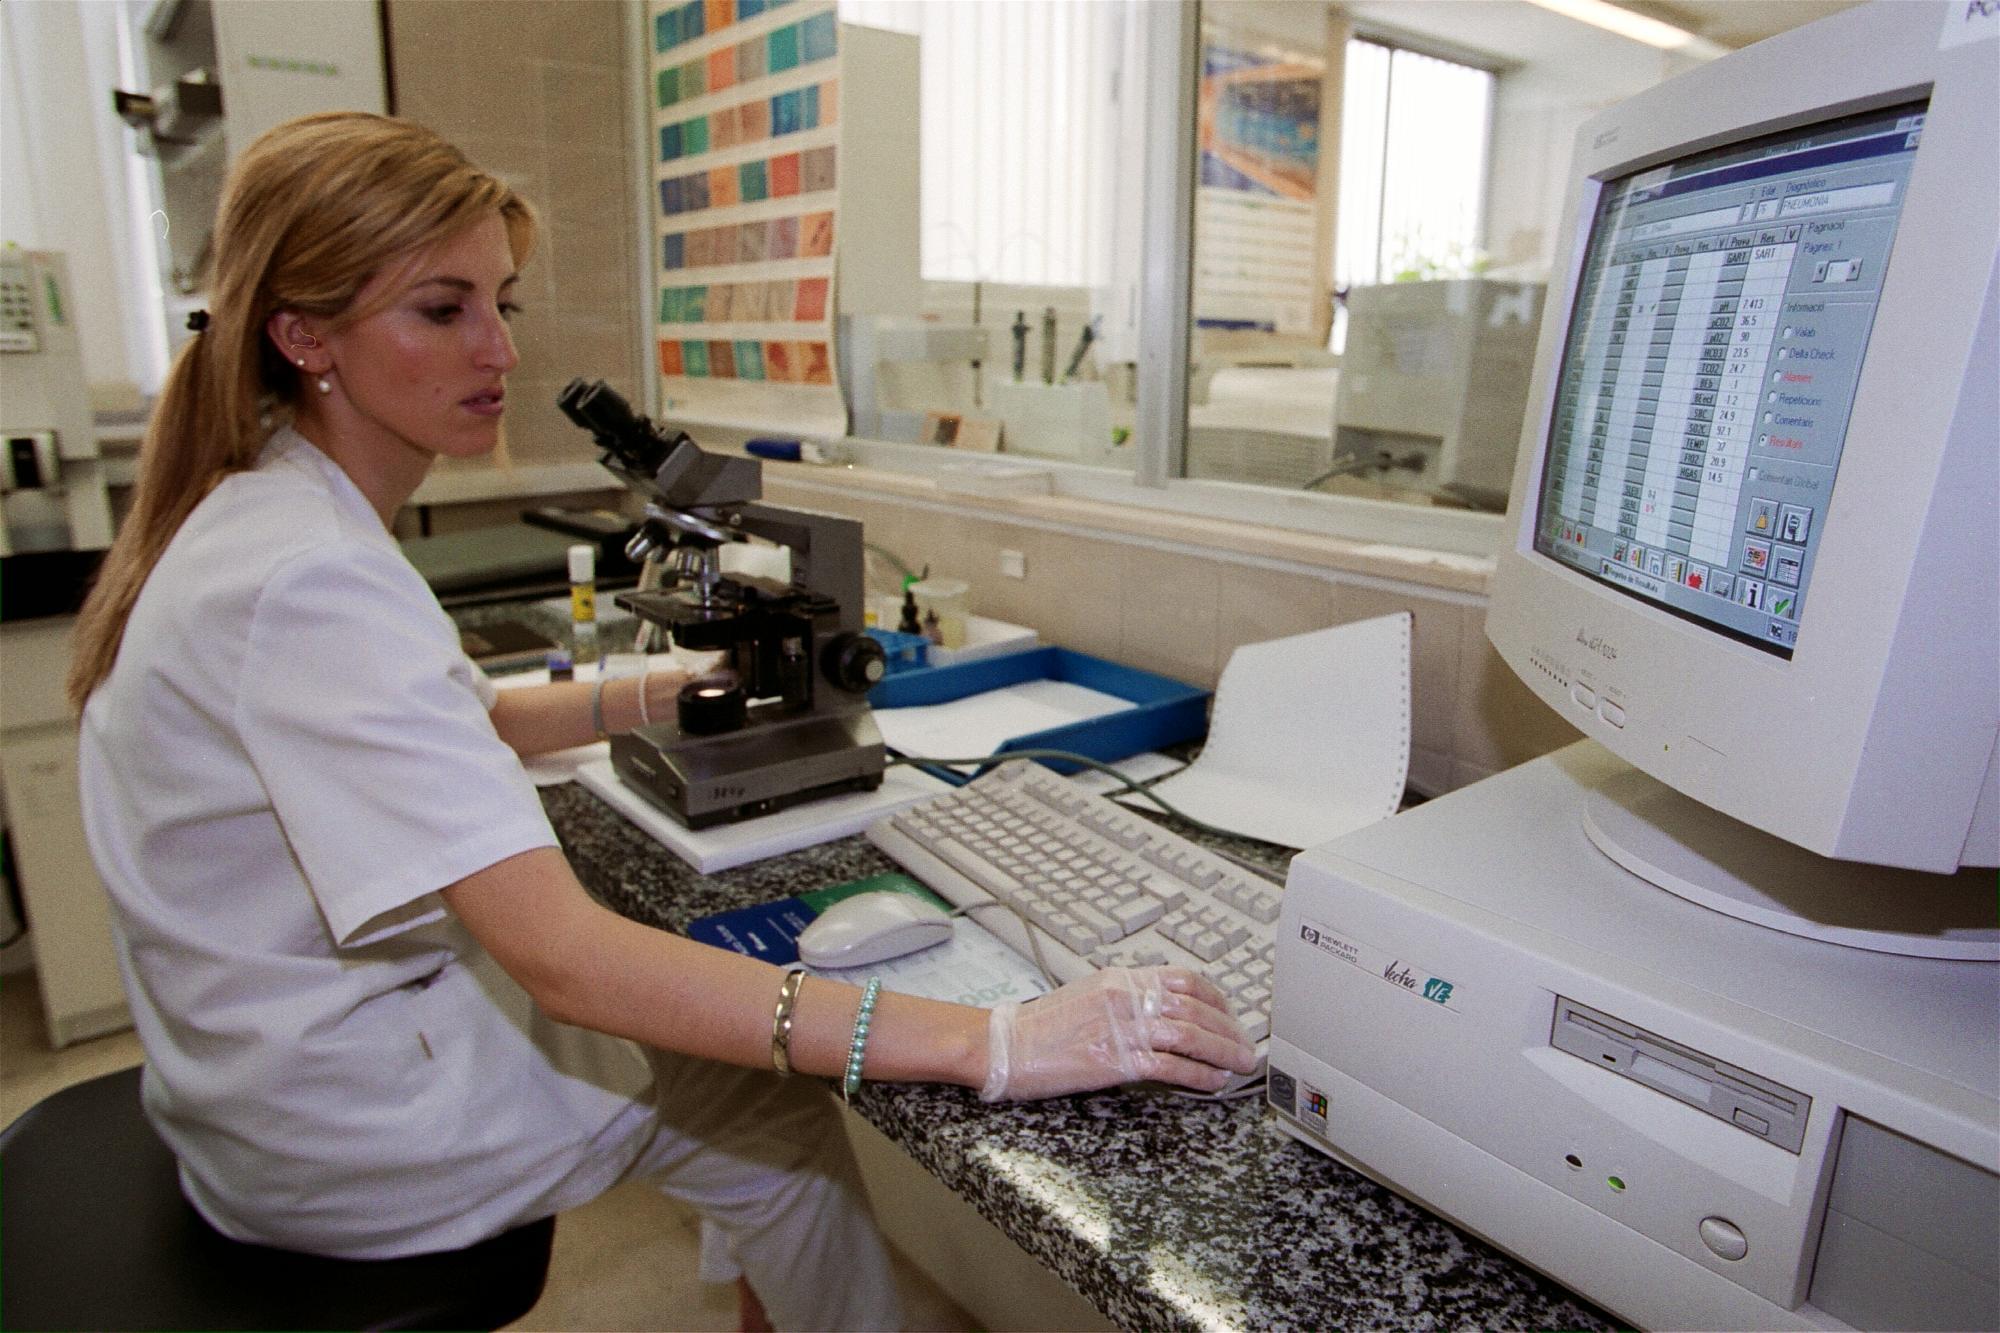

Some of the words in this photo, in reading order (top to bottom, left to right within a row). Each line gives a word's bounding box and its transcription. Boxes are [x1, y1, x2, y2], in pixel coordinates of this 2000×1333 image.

[1782, 195, 1830, 210] PNEUMONIA
[1788, 229, 1796, 240] V
[1719, 302, 1729, 312] pH
[1810, 348, 1836, 360] Check
[1321, 933, 1359, 954] HEWLETT
[1319, 941, 1358, 964] PACKARD
[1384, 959, 1418, 990] Vectra
